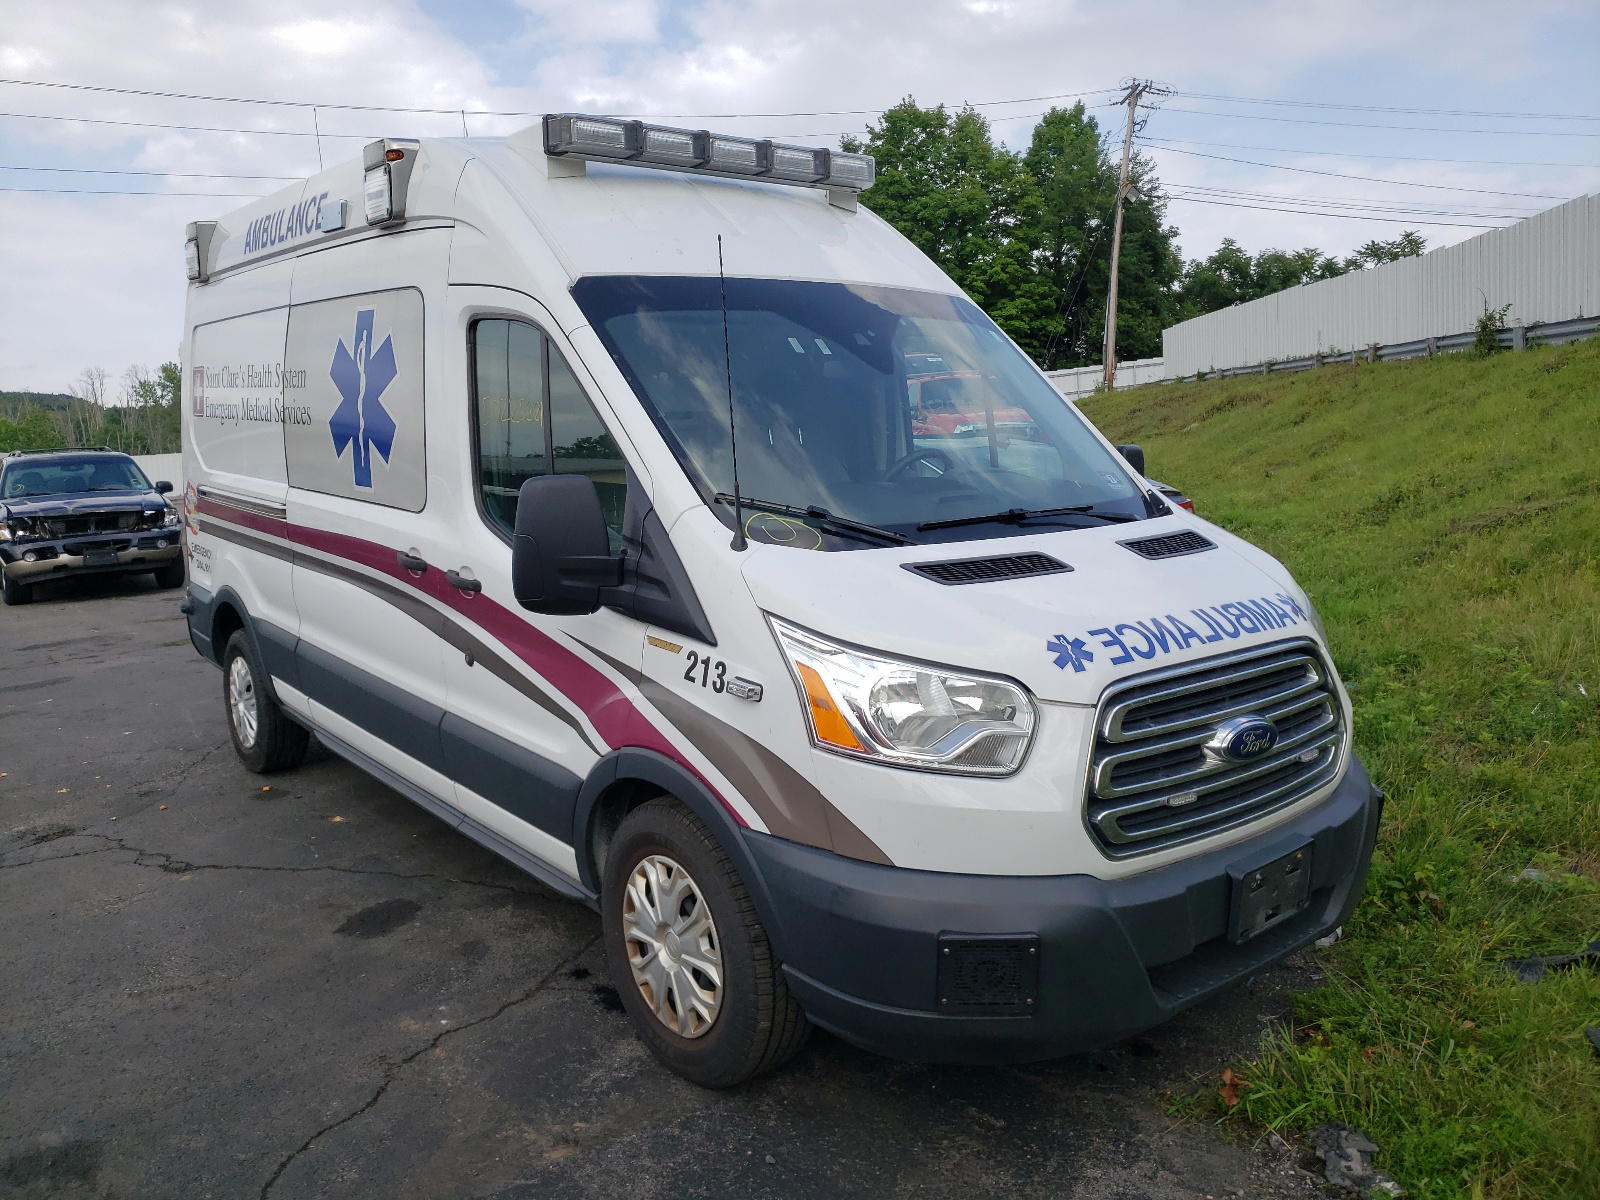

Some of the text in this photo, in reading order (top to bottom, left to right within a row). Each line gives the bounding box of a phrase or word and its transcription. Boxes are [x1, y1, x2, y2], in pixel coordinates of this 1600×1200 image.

[244, 192, 328, 255] AMBULANCE
[205, 366, 220, 389] Saint
[221, 364, 245, 389] Clare's
[247, 363, 273, 389] Health
[205, 396, 312, 426] Emergency Medical Services
[683, 650, 727, 694] 213
[1240, 729, 1272, 755] Ford
